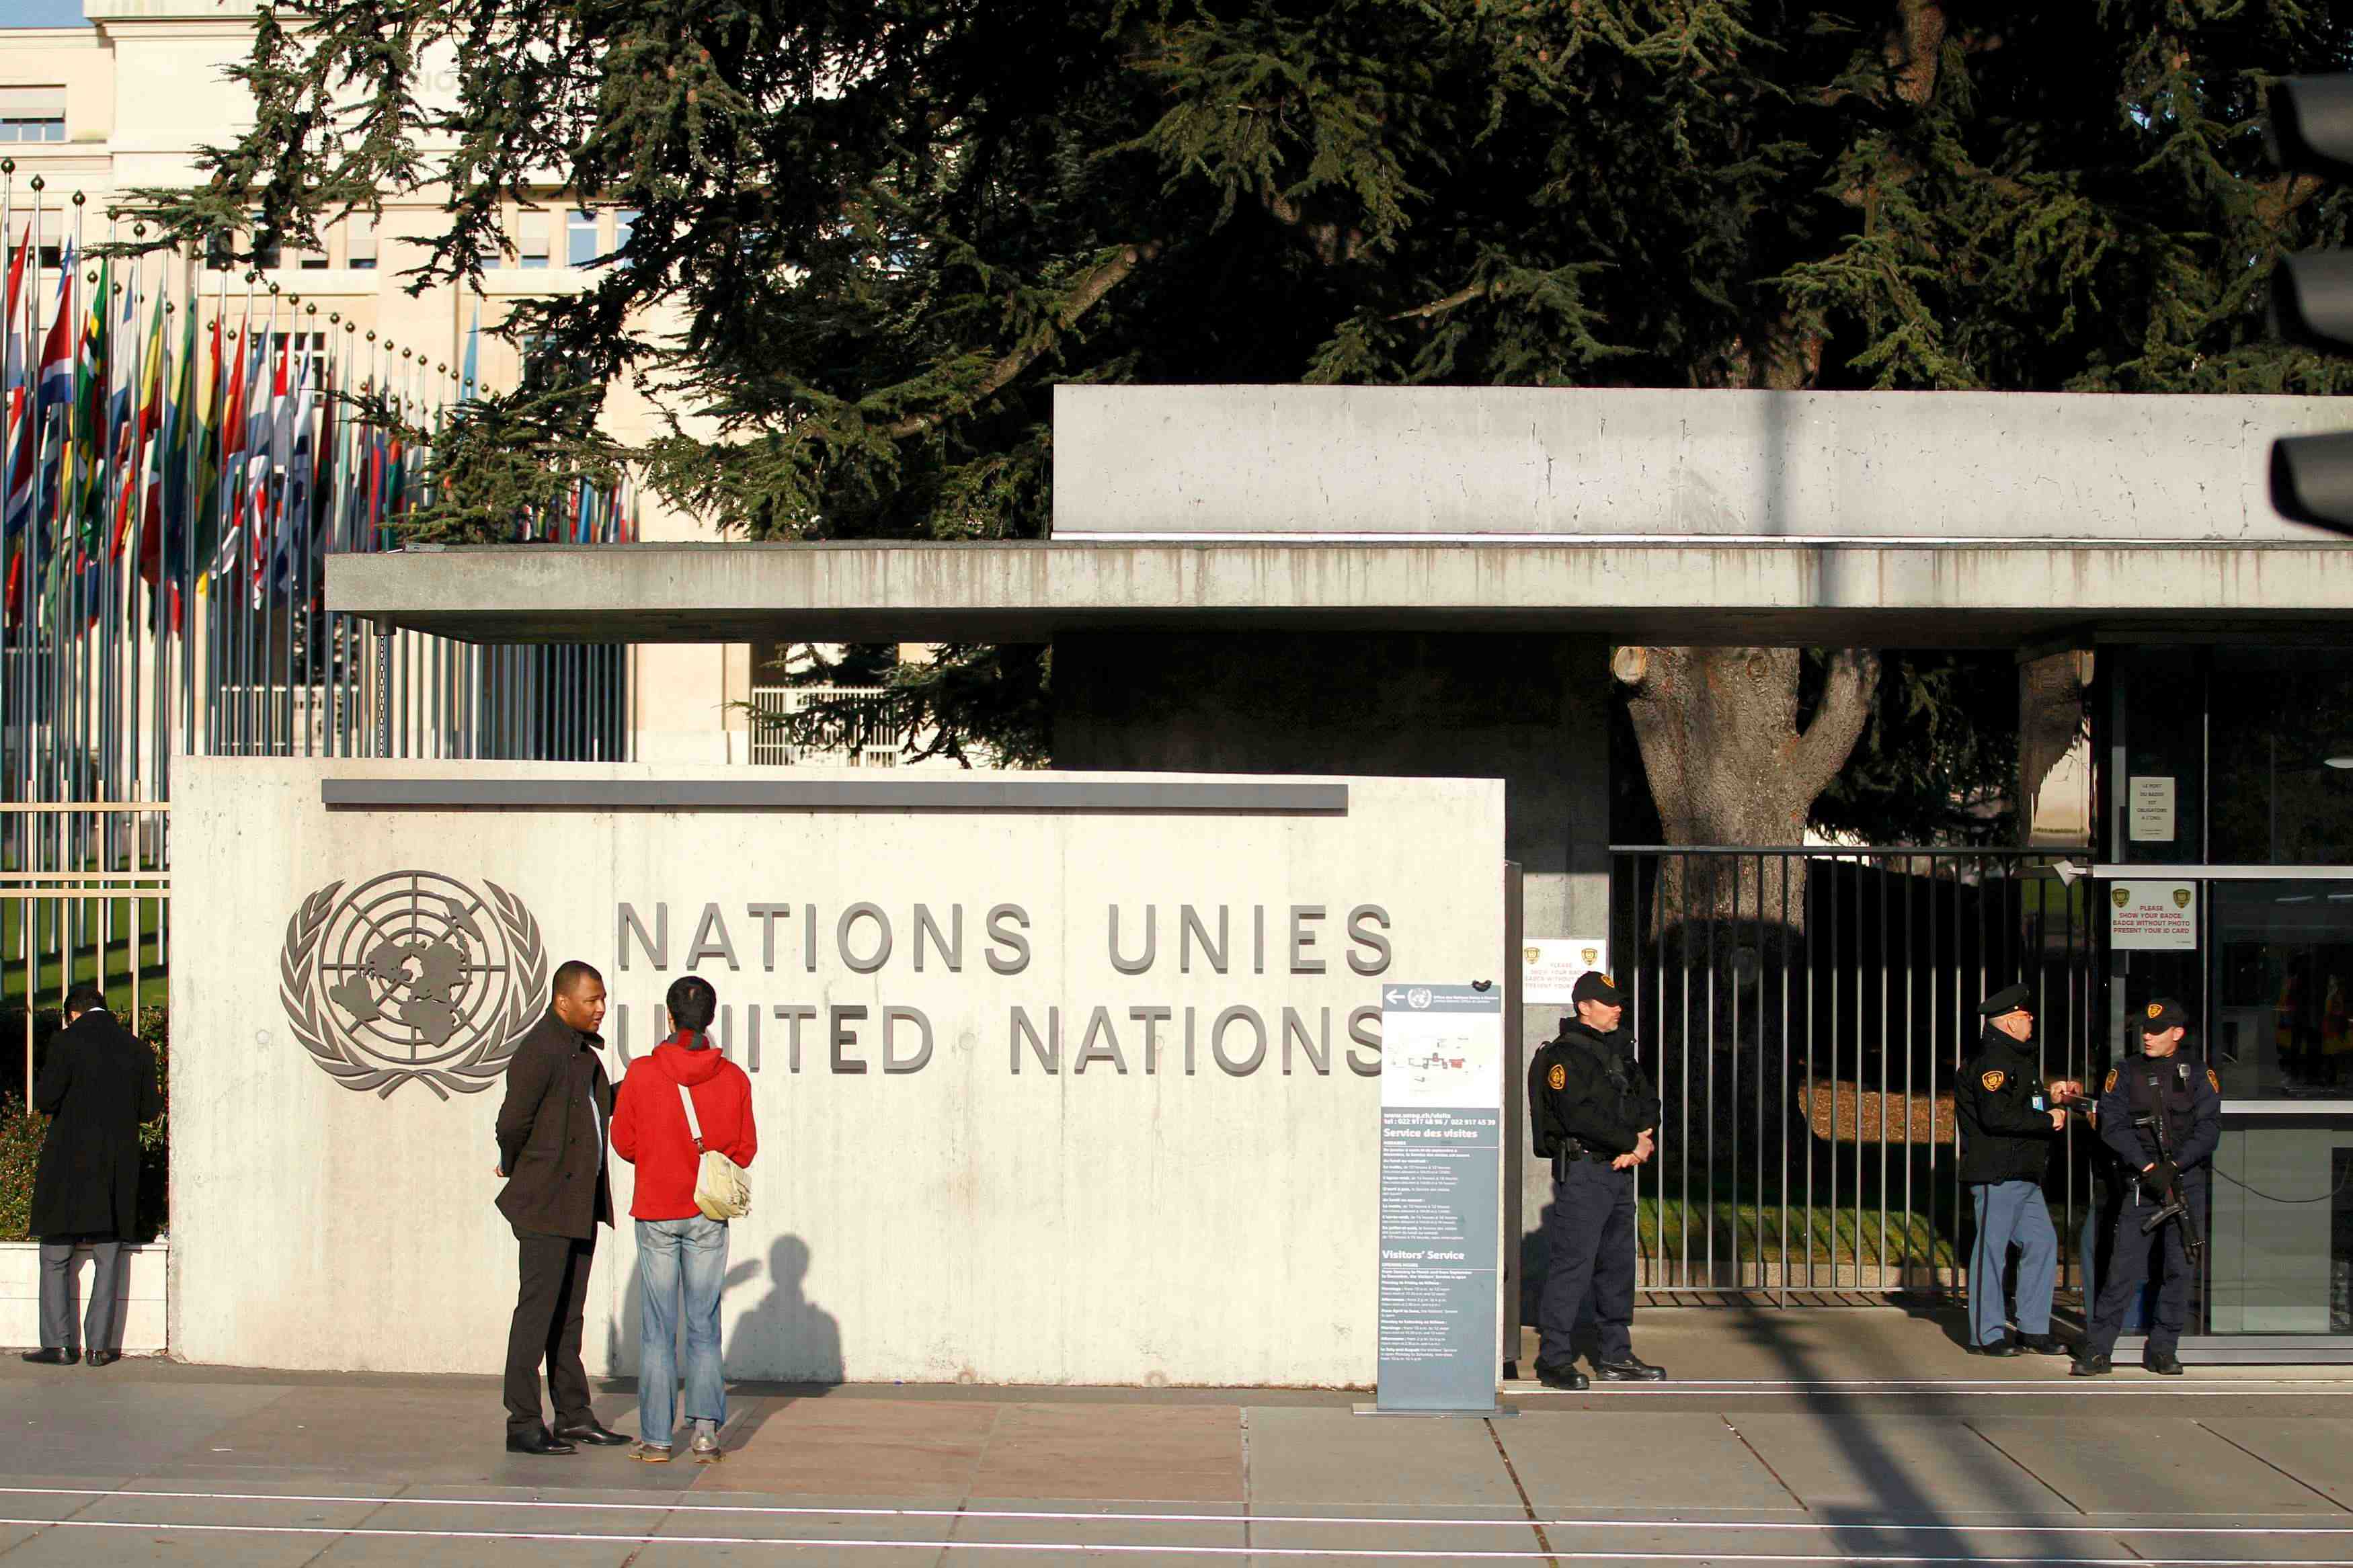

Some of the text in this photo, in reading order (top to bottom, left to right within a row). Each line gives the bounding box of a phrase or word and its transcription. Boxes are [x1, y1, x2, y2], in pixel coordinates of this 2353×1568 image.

[616, 901, 1392, 977] NATIONS UNIES
[1010, 1005, 1382, 1077] NATIONS
[1384, 1128, 1478, 1138] Service des visites
[1427, 1250, 1465, 1260] Service
